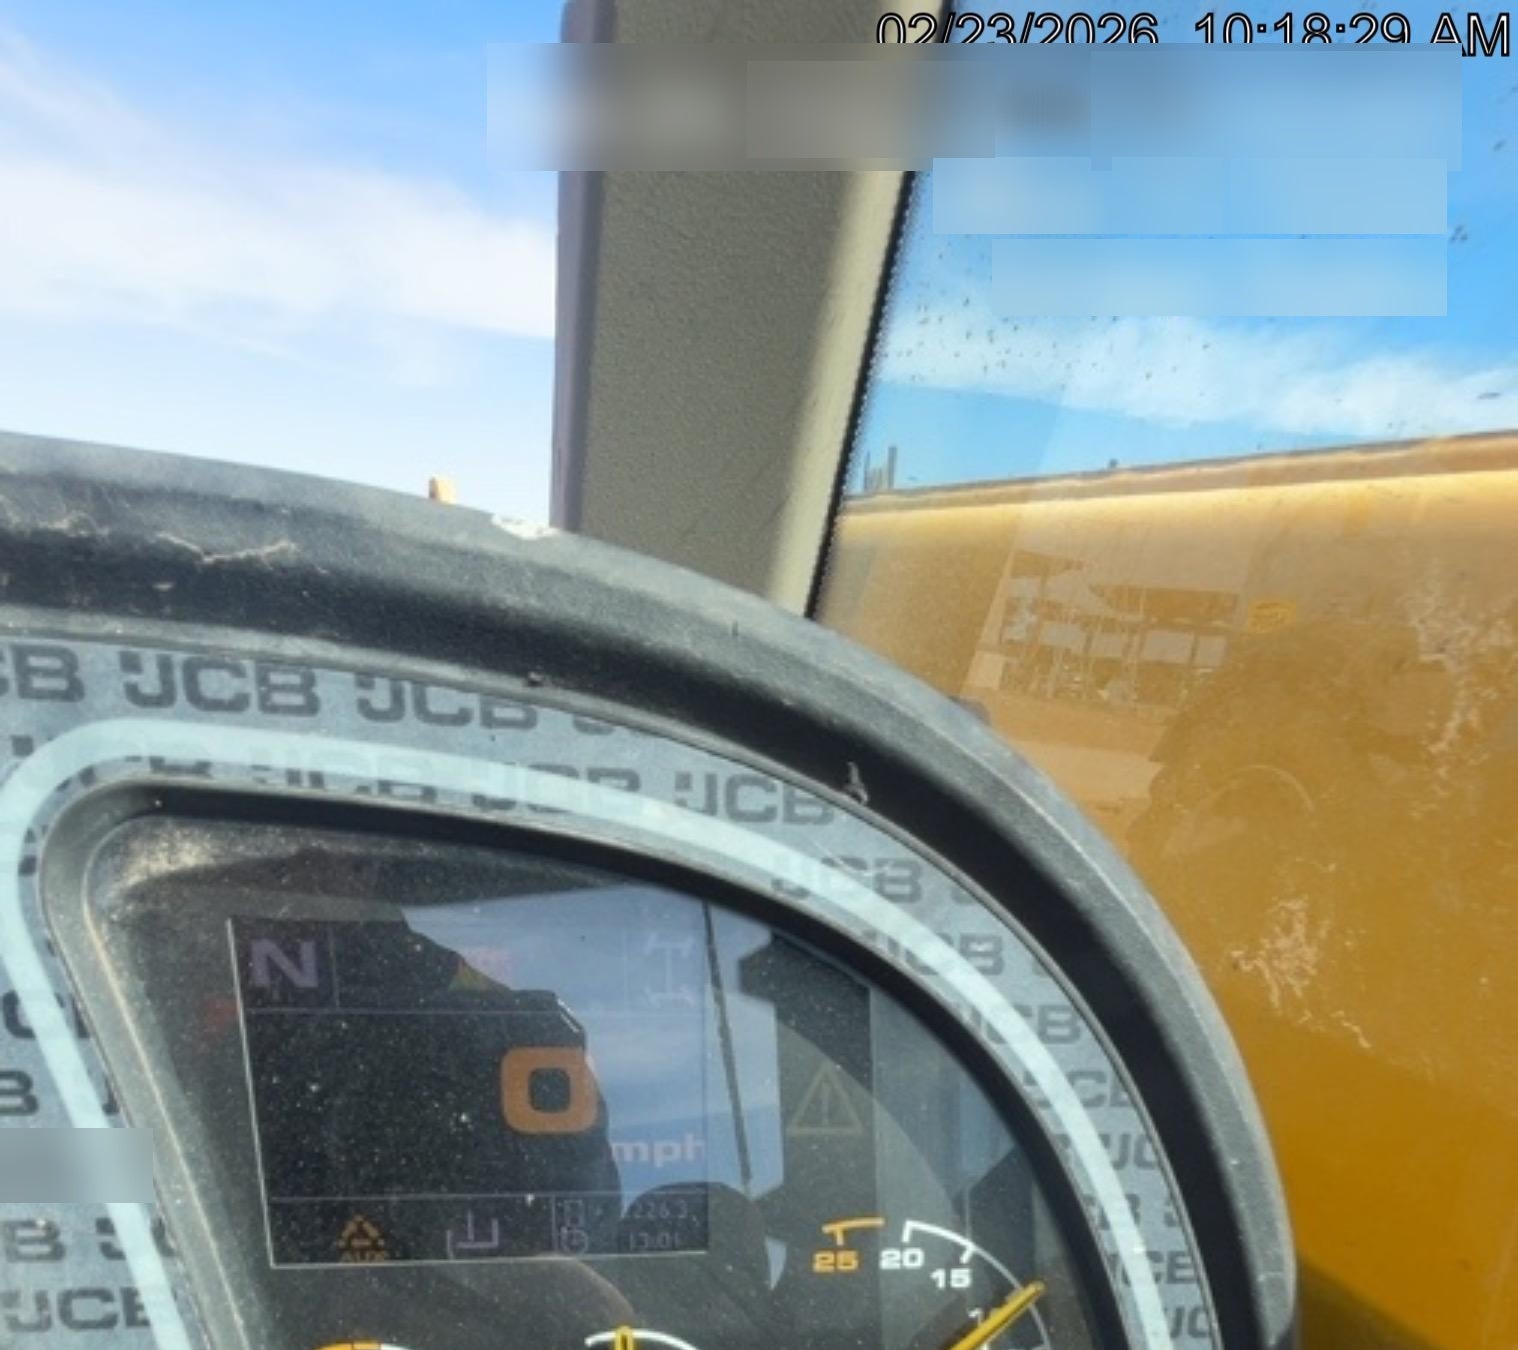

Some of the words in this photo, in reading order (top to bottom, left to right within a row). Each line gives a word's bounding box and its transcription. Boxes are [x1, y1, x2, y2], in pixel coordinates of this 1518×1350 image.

[117, 649, 322, 718] JCB
[250, 937, 320, 988] N
[501, 1046, 599, 1134] 0
[608, 1133, 707, 1168] mph
[812, 1251, 860, 1273] 25
[878, 1247, 925, 1270] 20
[930, 1268, 973, 1289] 15
